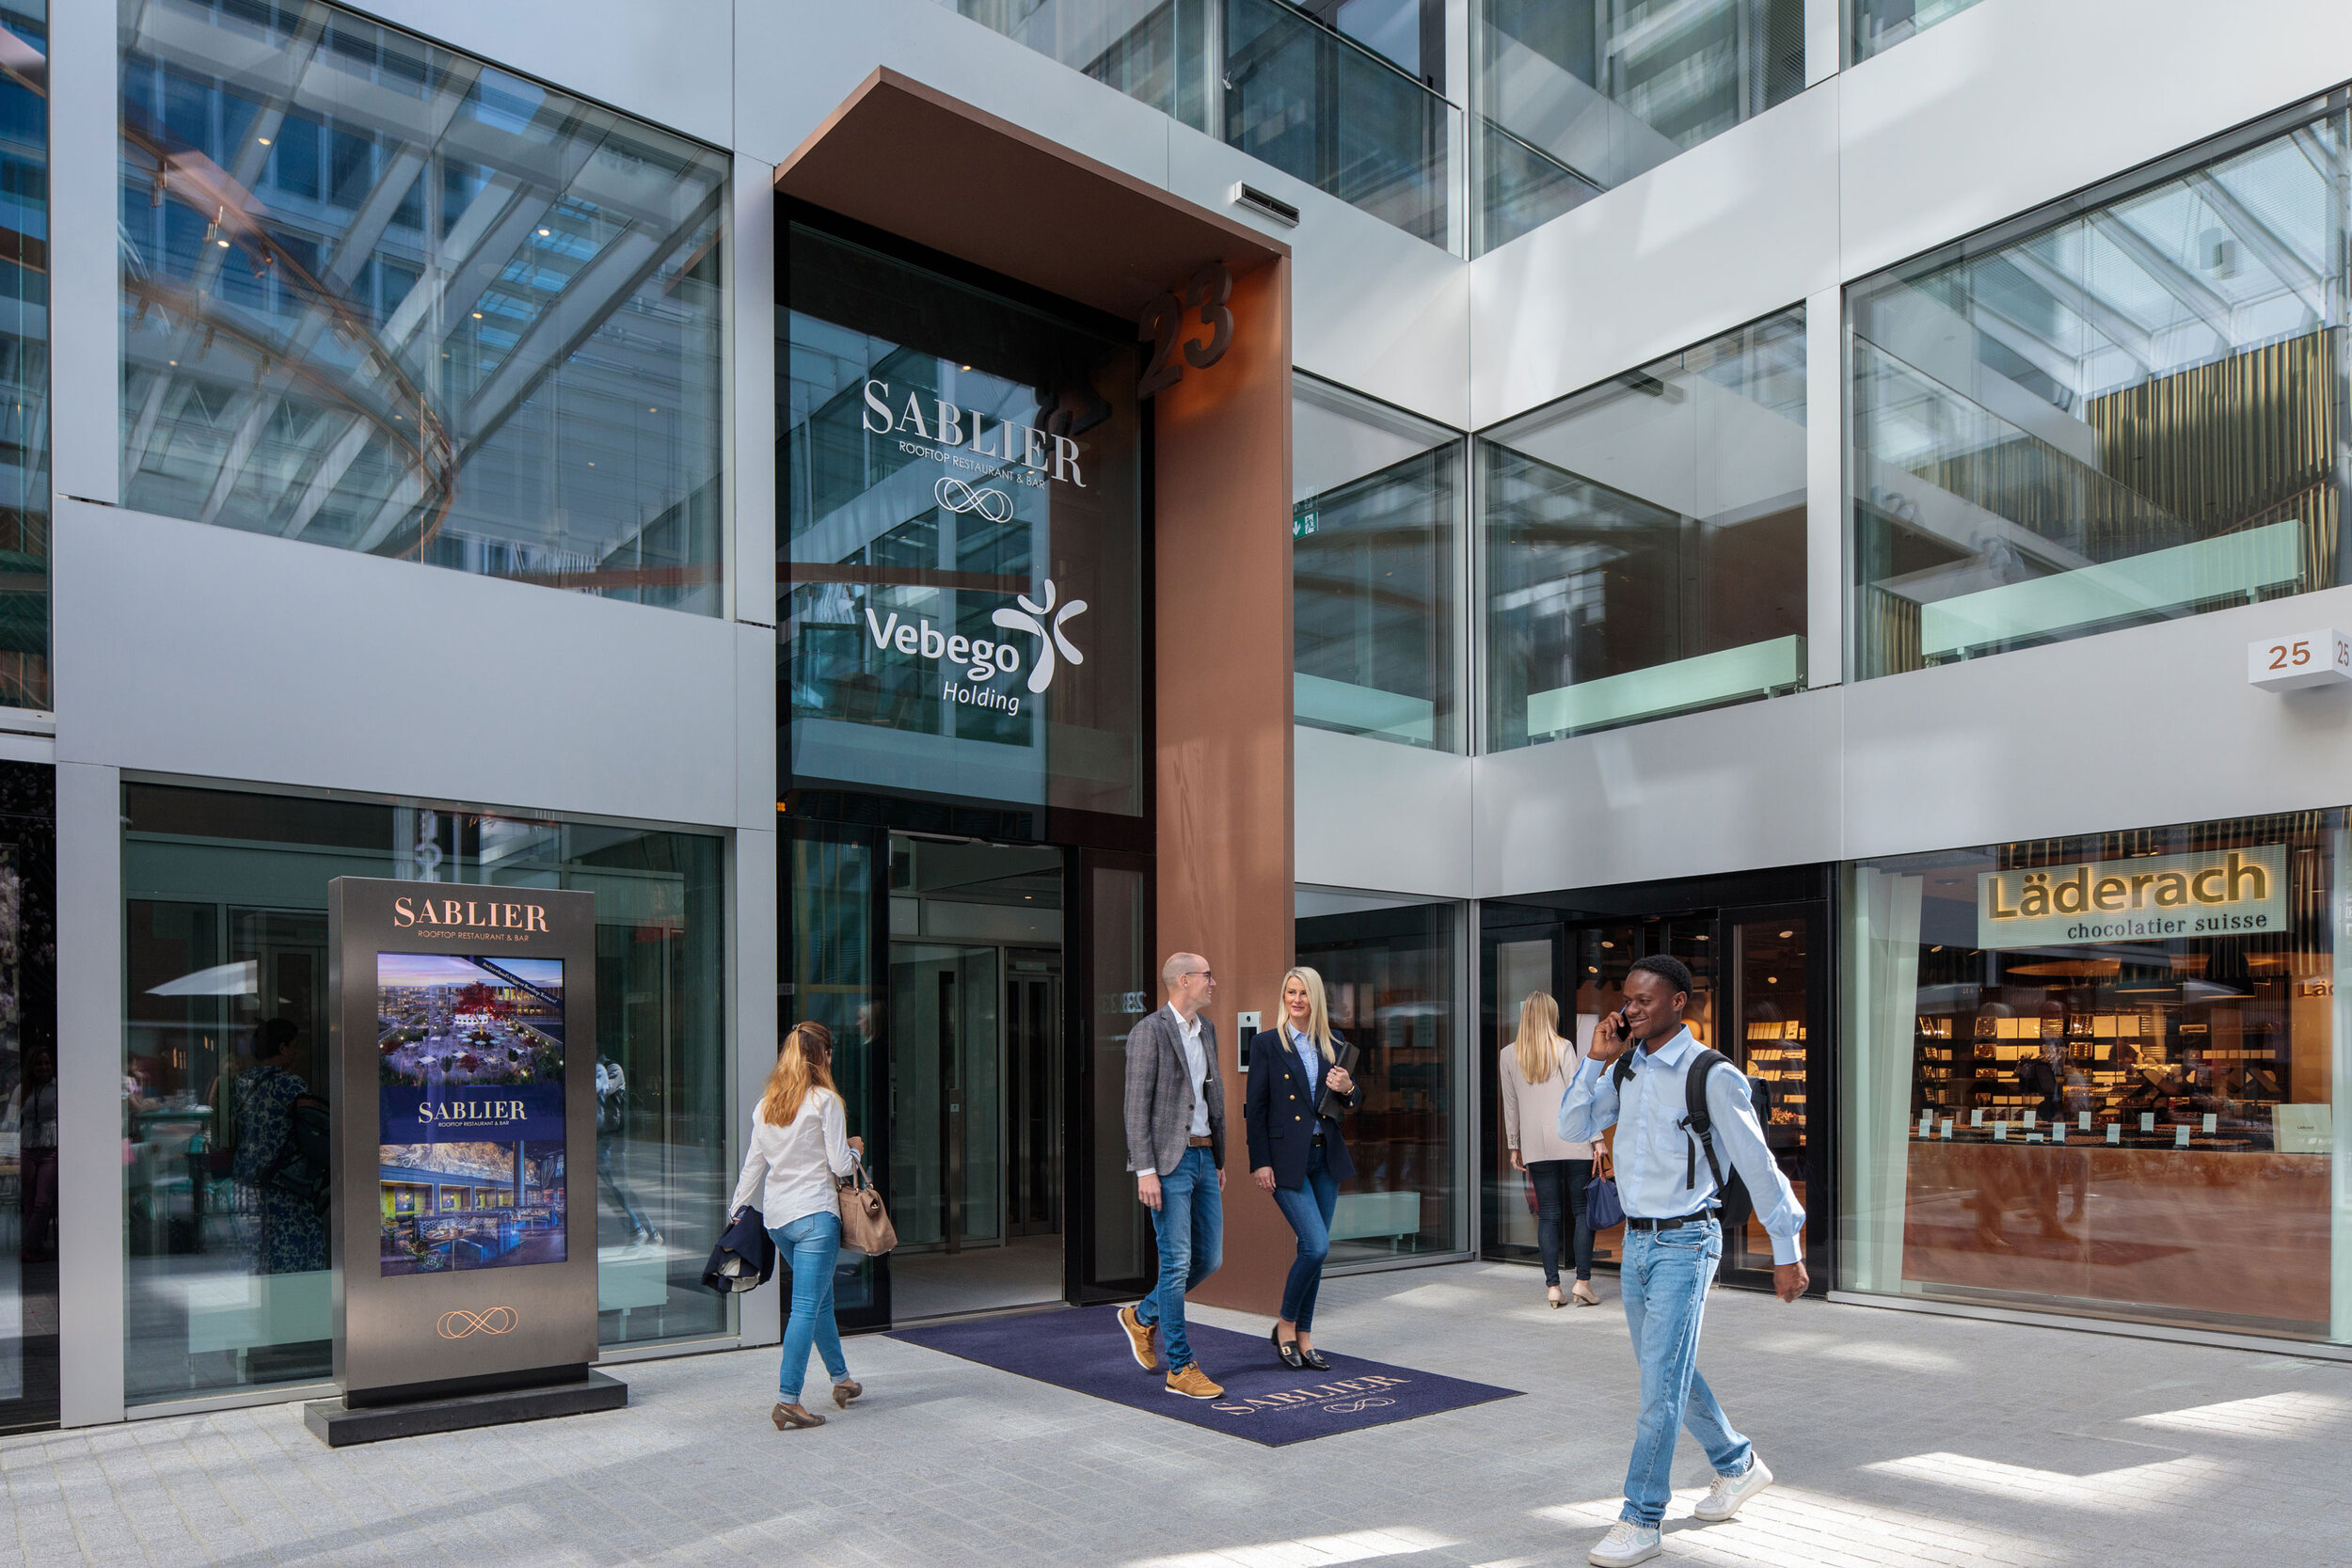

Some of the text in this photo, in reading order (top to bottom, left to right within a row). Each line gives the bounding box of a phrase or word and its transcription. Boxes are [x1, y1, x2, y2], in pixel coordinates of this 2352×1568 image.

[1137, 261, 1234, 399] 23
[863, 379, 1087, 488] SABLIER
[898, 440, 1045, 490] ROOFTOP RESTAURANT & BAR
[865, 608, 1020, 681] Vebego
[2268, 641, 2311, 671] 25
[2337, 640, 2350, 667] 25
[943, 681, 1020, 716] Holding
[1988, 852, 2266, 919] Läderach
[393, 896, 550, 933] SABLIER
[2067, 913, 2267, 939] chocolatier suisse
[418, 929, 456, 939] ROOFTOP
[457, 932, 504, 942] RESTAURANT
[418, 1101, 528, 1124] SABLIER
[1211, 1375, 1412, 1416] SABLIER
